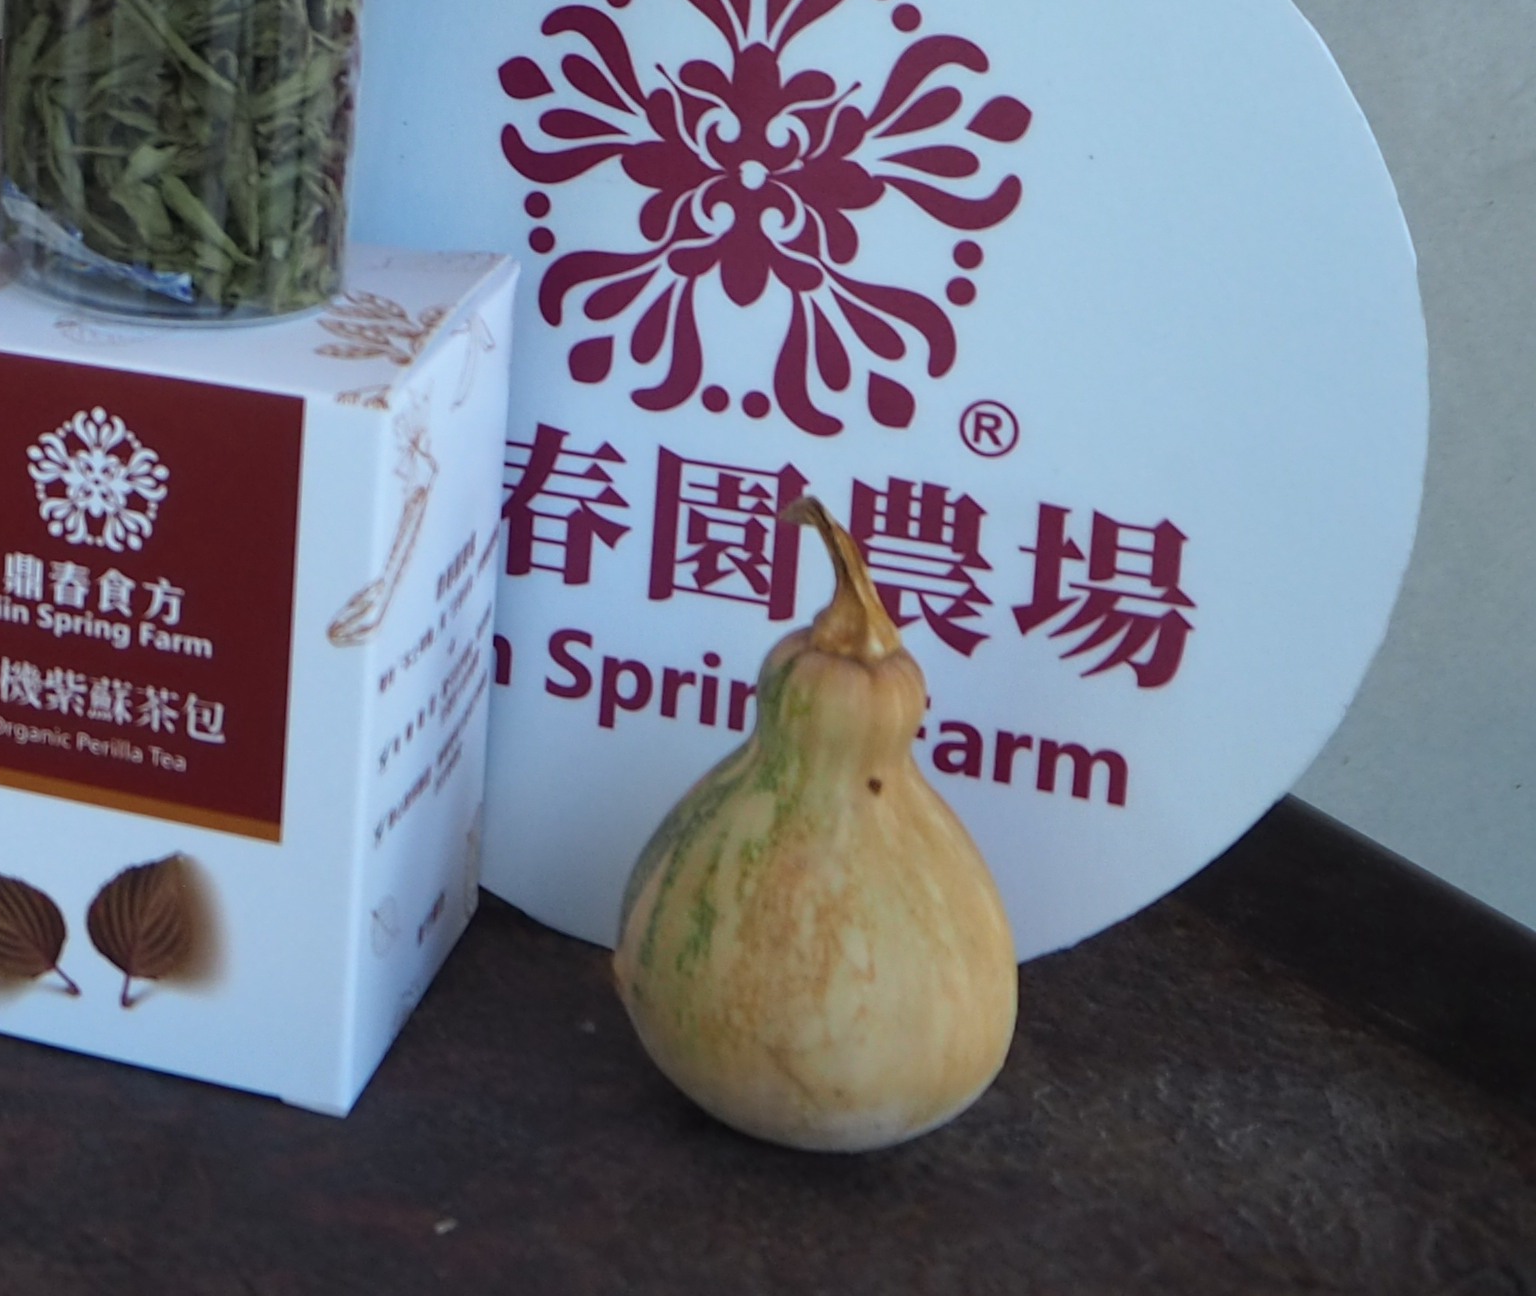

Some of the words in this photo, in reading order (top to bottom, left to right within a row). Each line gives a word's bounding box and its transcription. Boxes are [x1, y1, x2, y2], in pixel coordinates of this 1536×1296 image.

[3, 551, 186, 625] 鼎春食方
[501, 422, 1197, 689] 春園農場
[36, 603, 131, 649] Spring
[138, 621, 213, 658] Farm
[76, 731, 144, 764] Perilla
[148, 745, 187, 772] Tea
[916, 694, 1128, 807] arm
